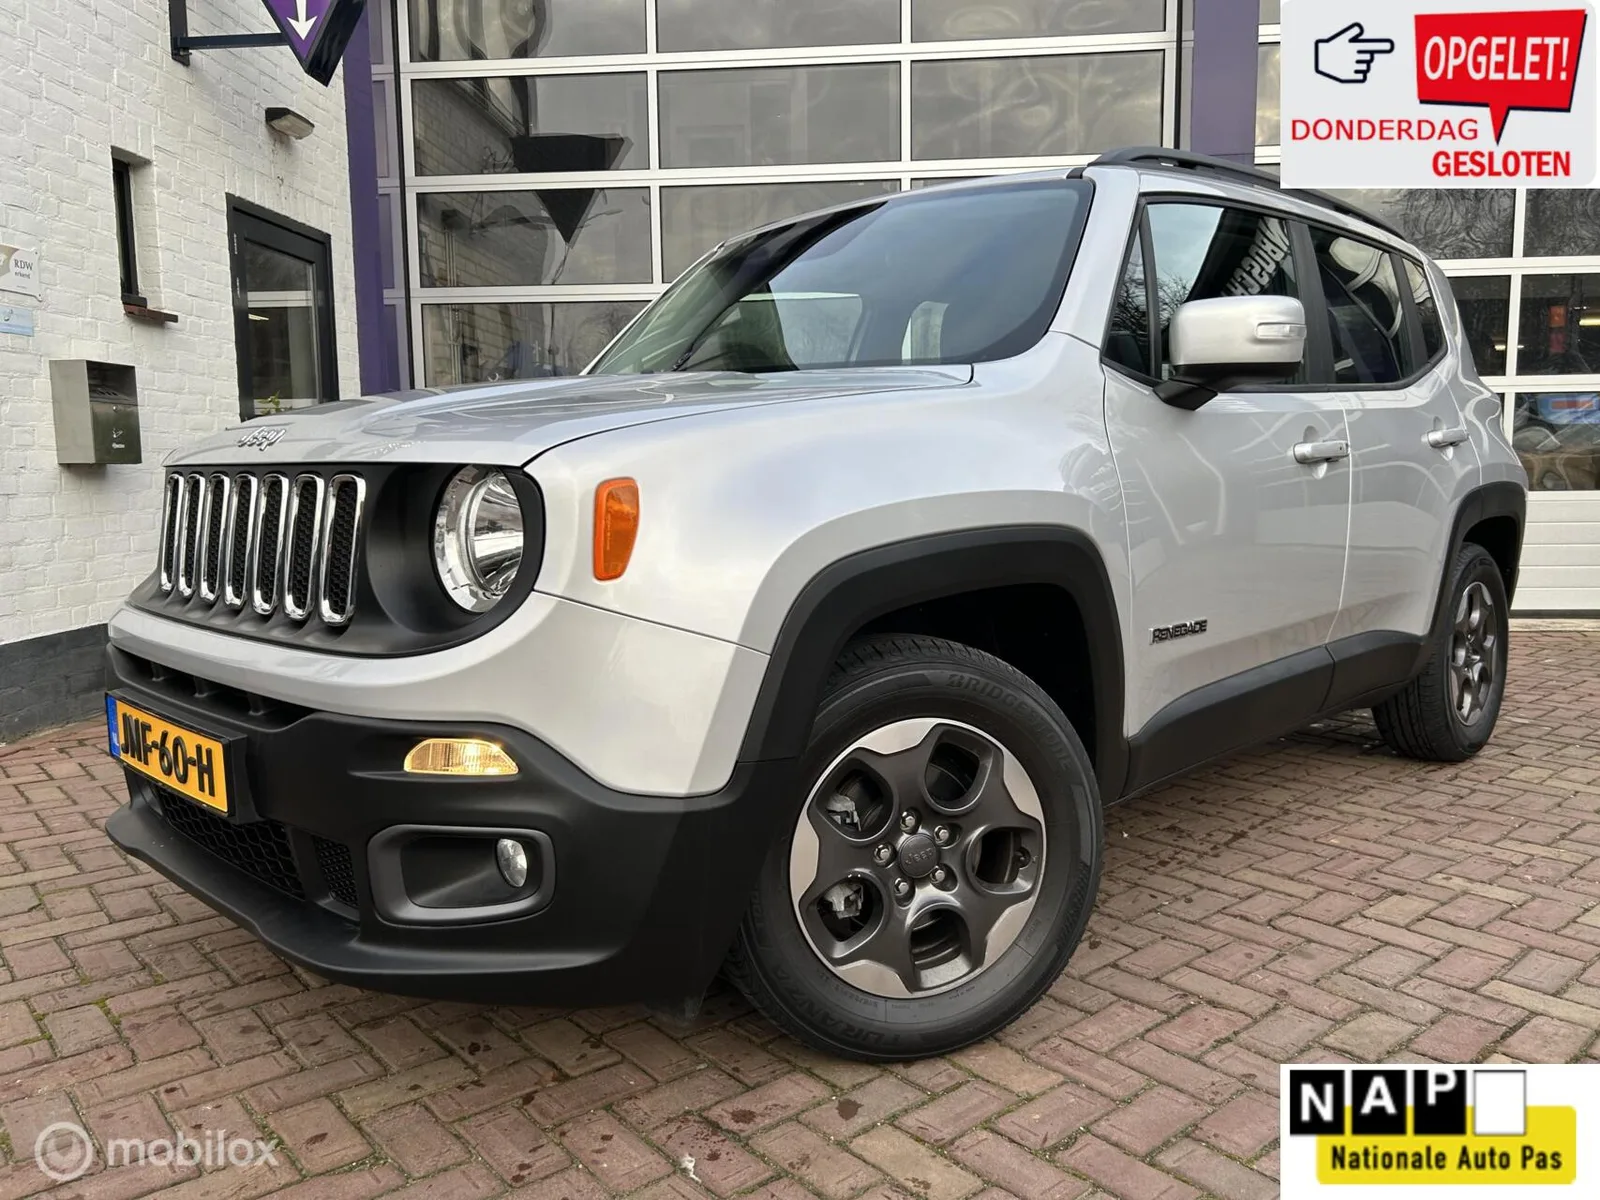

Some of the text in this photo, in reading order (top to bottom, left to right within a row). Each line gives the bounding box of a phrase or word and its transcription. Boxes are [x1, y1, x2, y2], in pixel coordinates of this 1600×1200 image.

[14, 258, 33, 270] RDW
[238, 427, 286, 451] Jeep
[1148, 618, 1208, 646] RENEGADE
[121, 712, 215, 797] JNF-60-H
